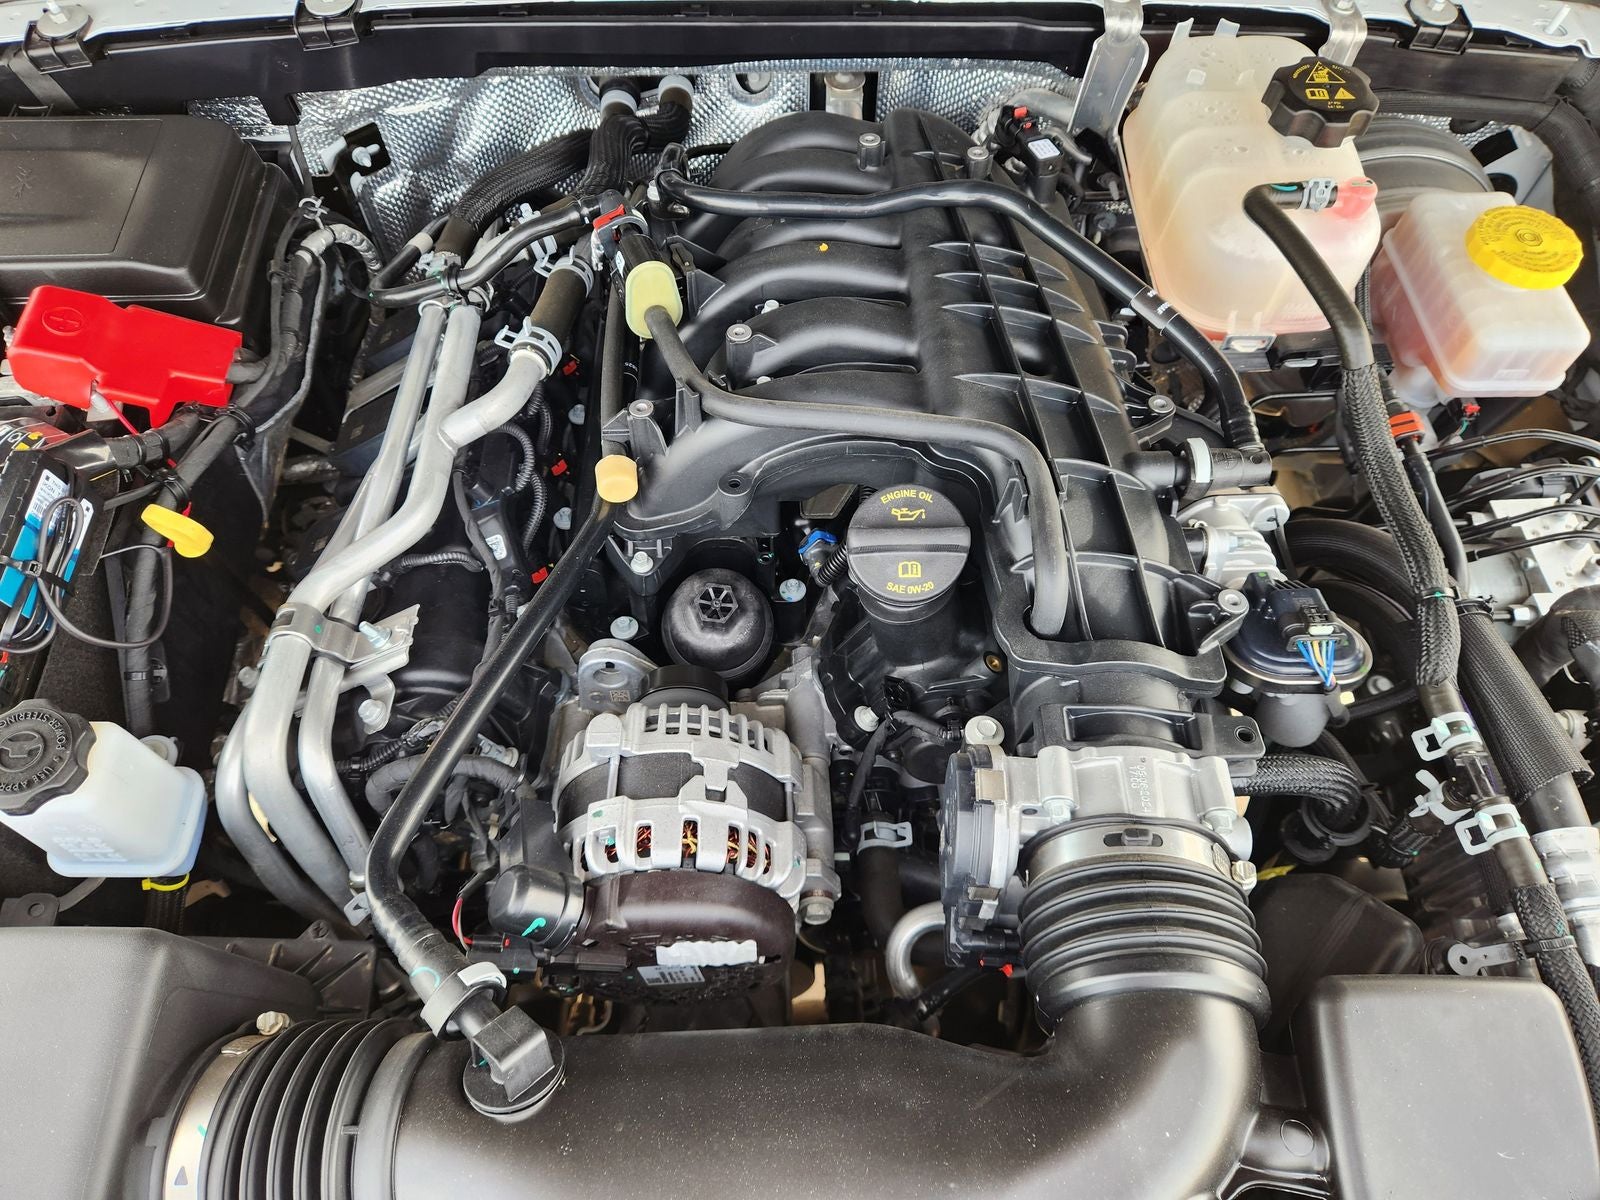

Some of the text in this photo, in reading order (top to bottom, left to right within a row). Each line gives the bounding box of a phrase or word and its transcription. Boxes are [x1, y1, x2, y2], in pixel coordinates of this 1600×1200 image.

[880, 489, 934, 504] ENGINE OIL
[886, 581, 935, 594] SAE 0W-20
[48, 718, 67, 751] POWER
[32, 766, 55, 783] USE
